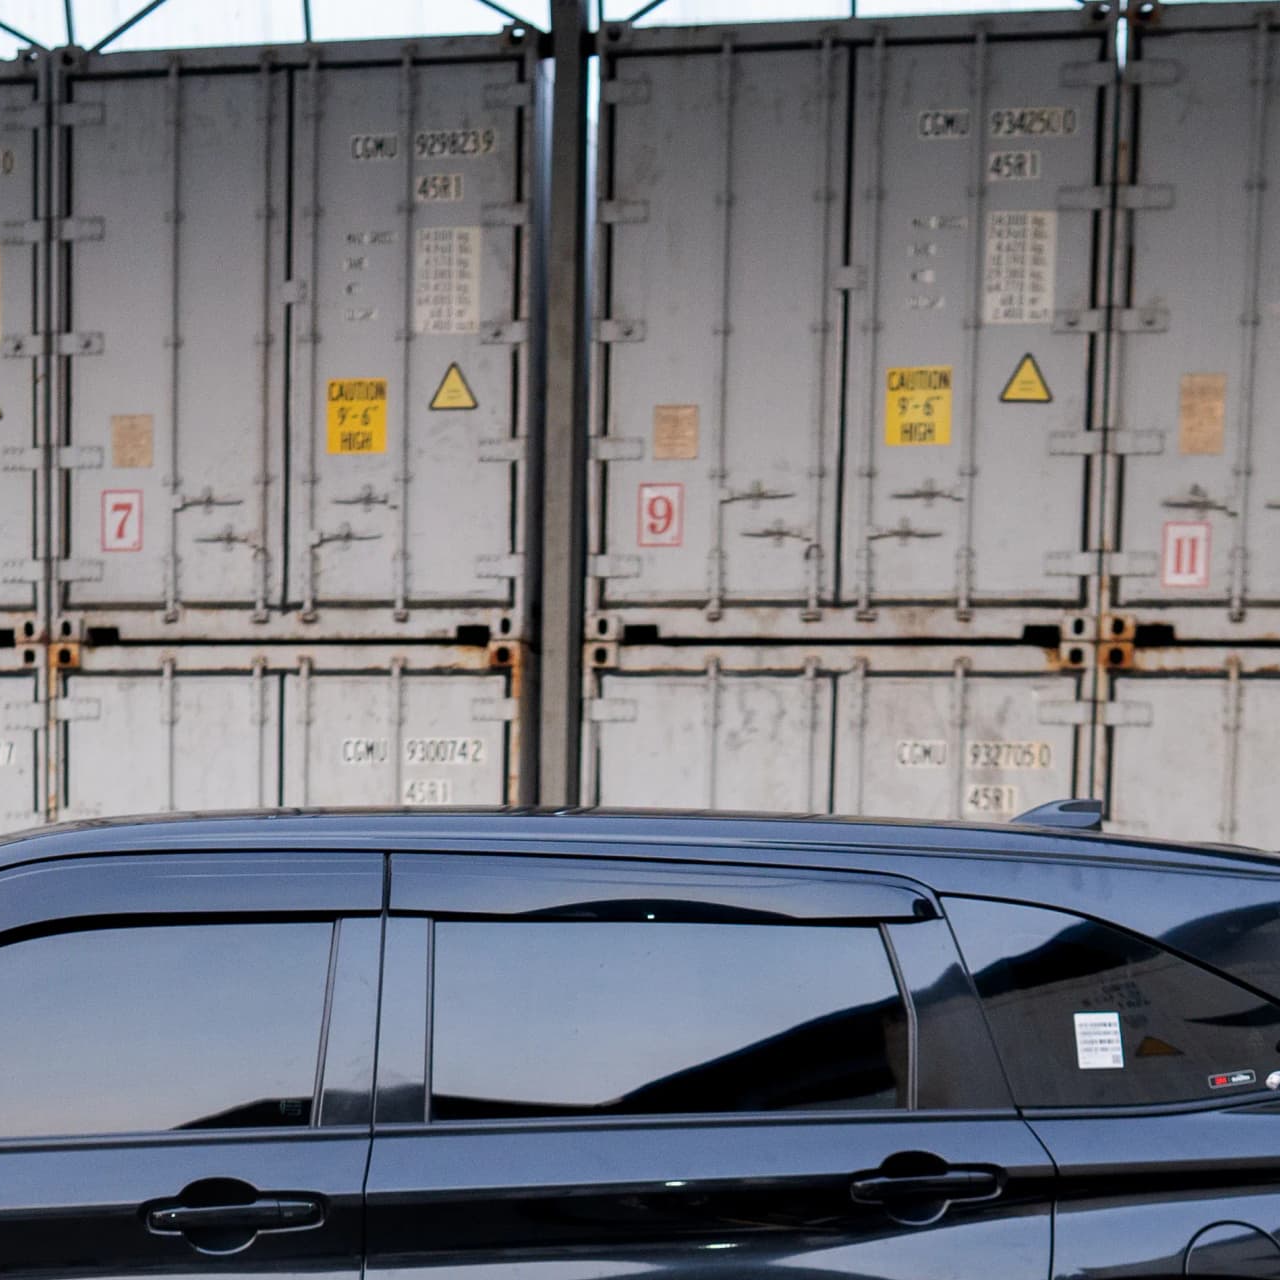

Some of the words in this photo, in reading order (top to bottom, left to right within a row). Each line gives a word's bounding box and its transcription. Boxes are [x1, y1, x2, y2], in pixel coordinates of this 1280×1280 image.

[111, 502, 133, 540] 7
[648, 496, 674, 534] 9
[1174, 537, 1197, 574] 11
